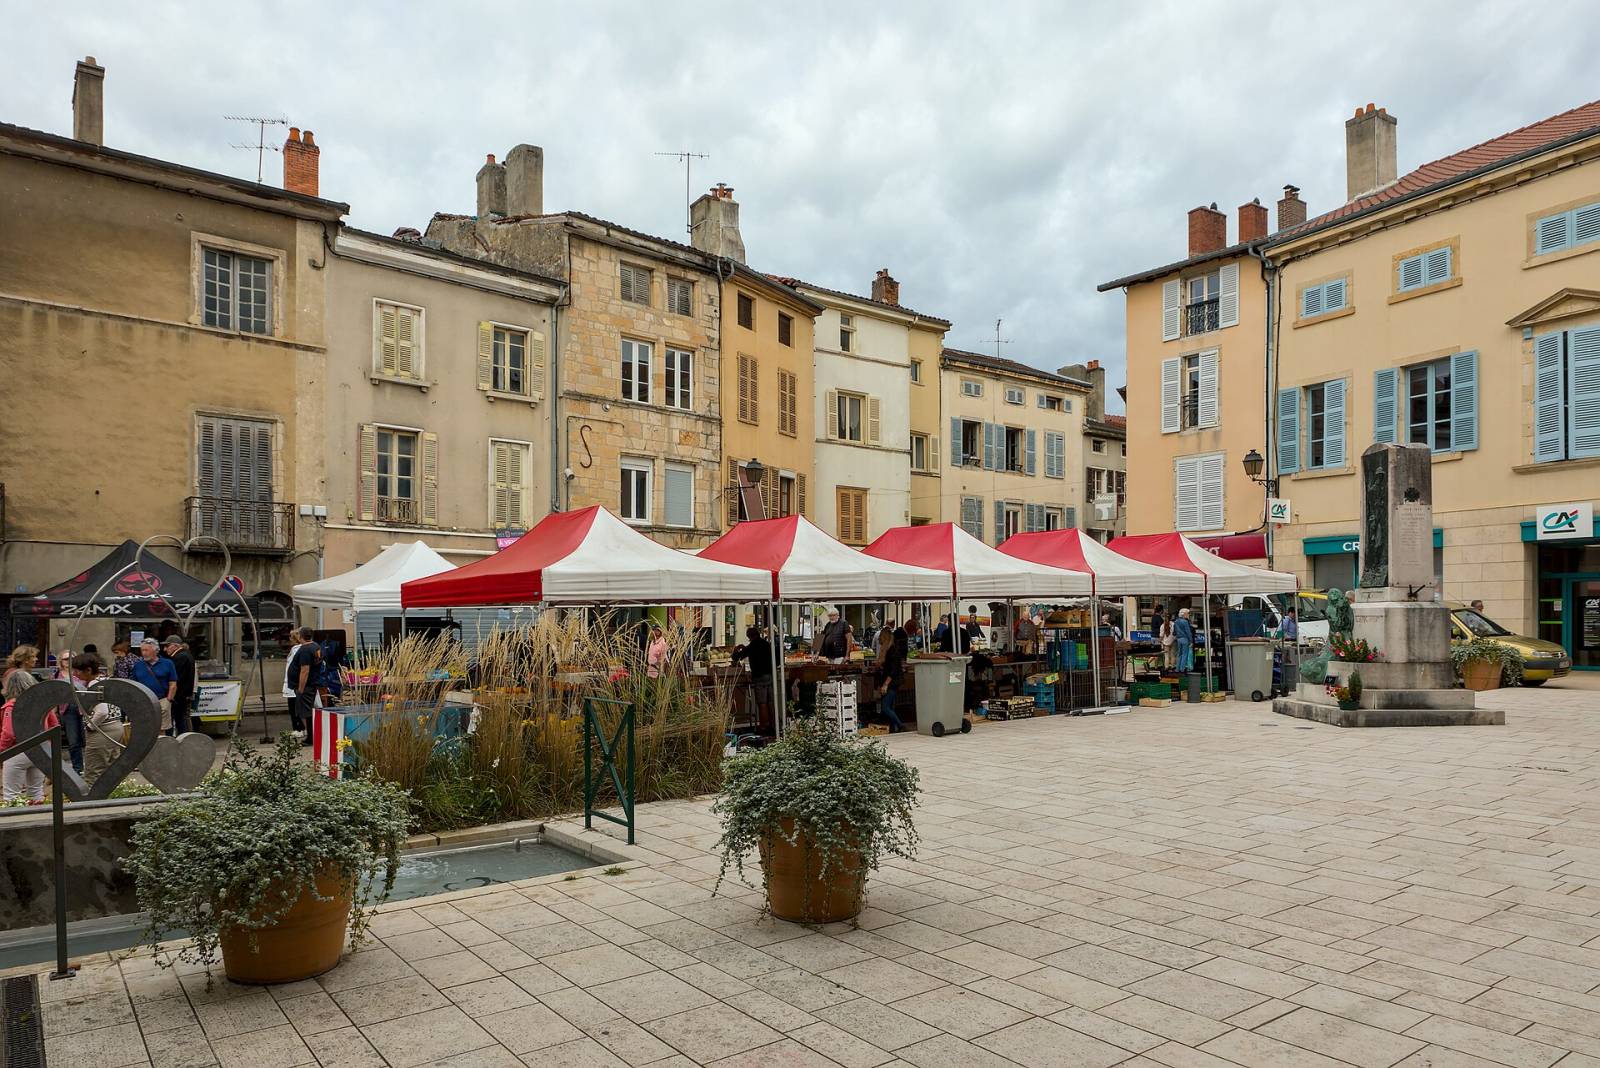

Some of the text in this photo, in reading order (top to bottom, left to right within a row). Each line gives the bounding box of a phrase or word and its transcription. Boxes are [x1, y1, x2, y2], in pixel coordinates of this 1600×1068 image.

[1542, 509, 1578, 529] CA
[60, 603, 133, 615] 24MX
[174, 603, 241, 614] 24MX
